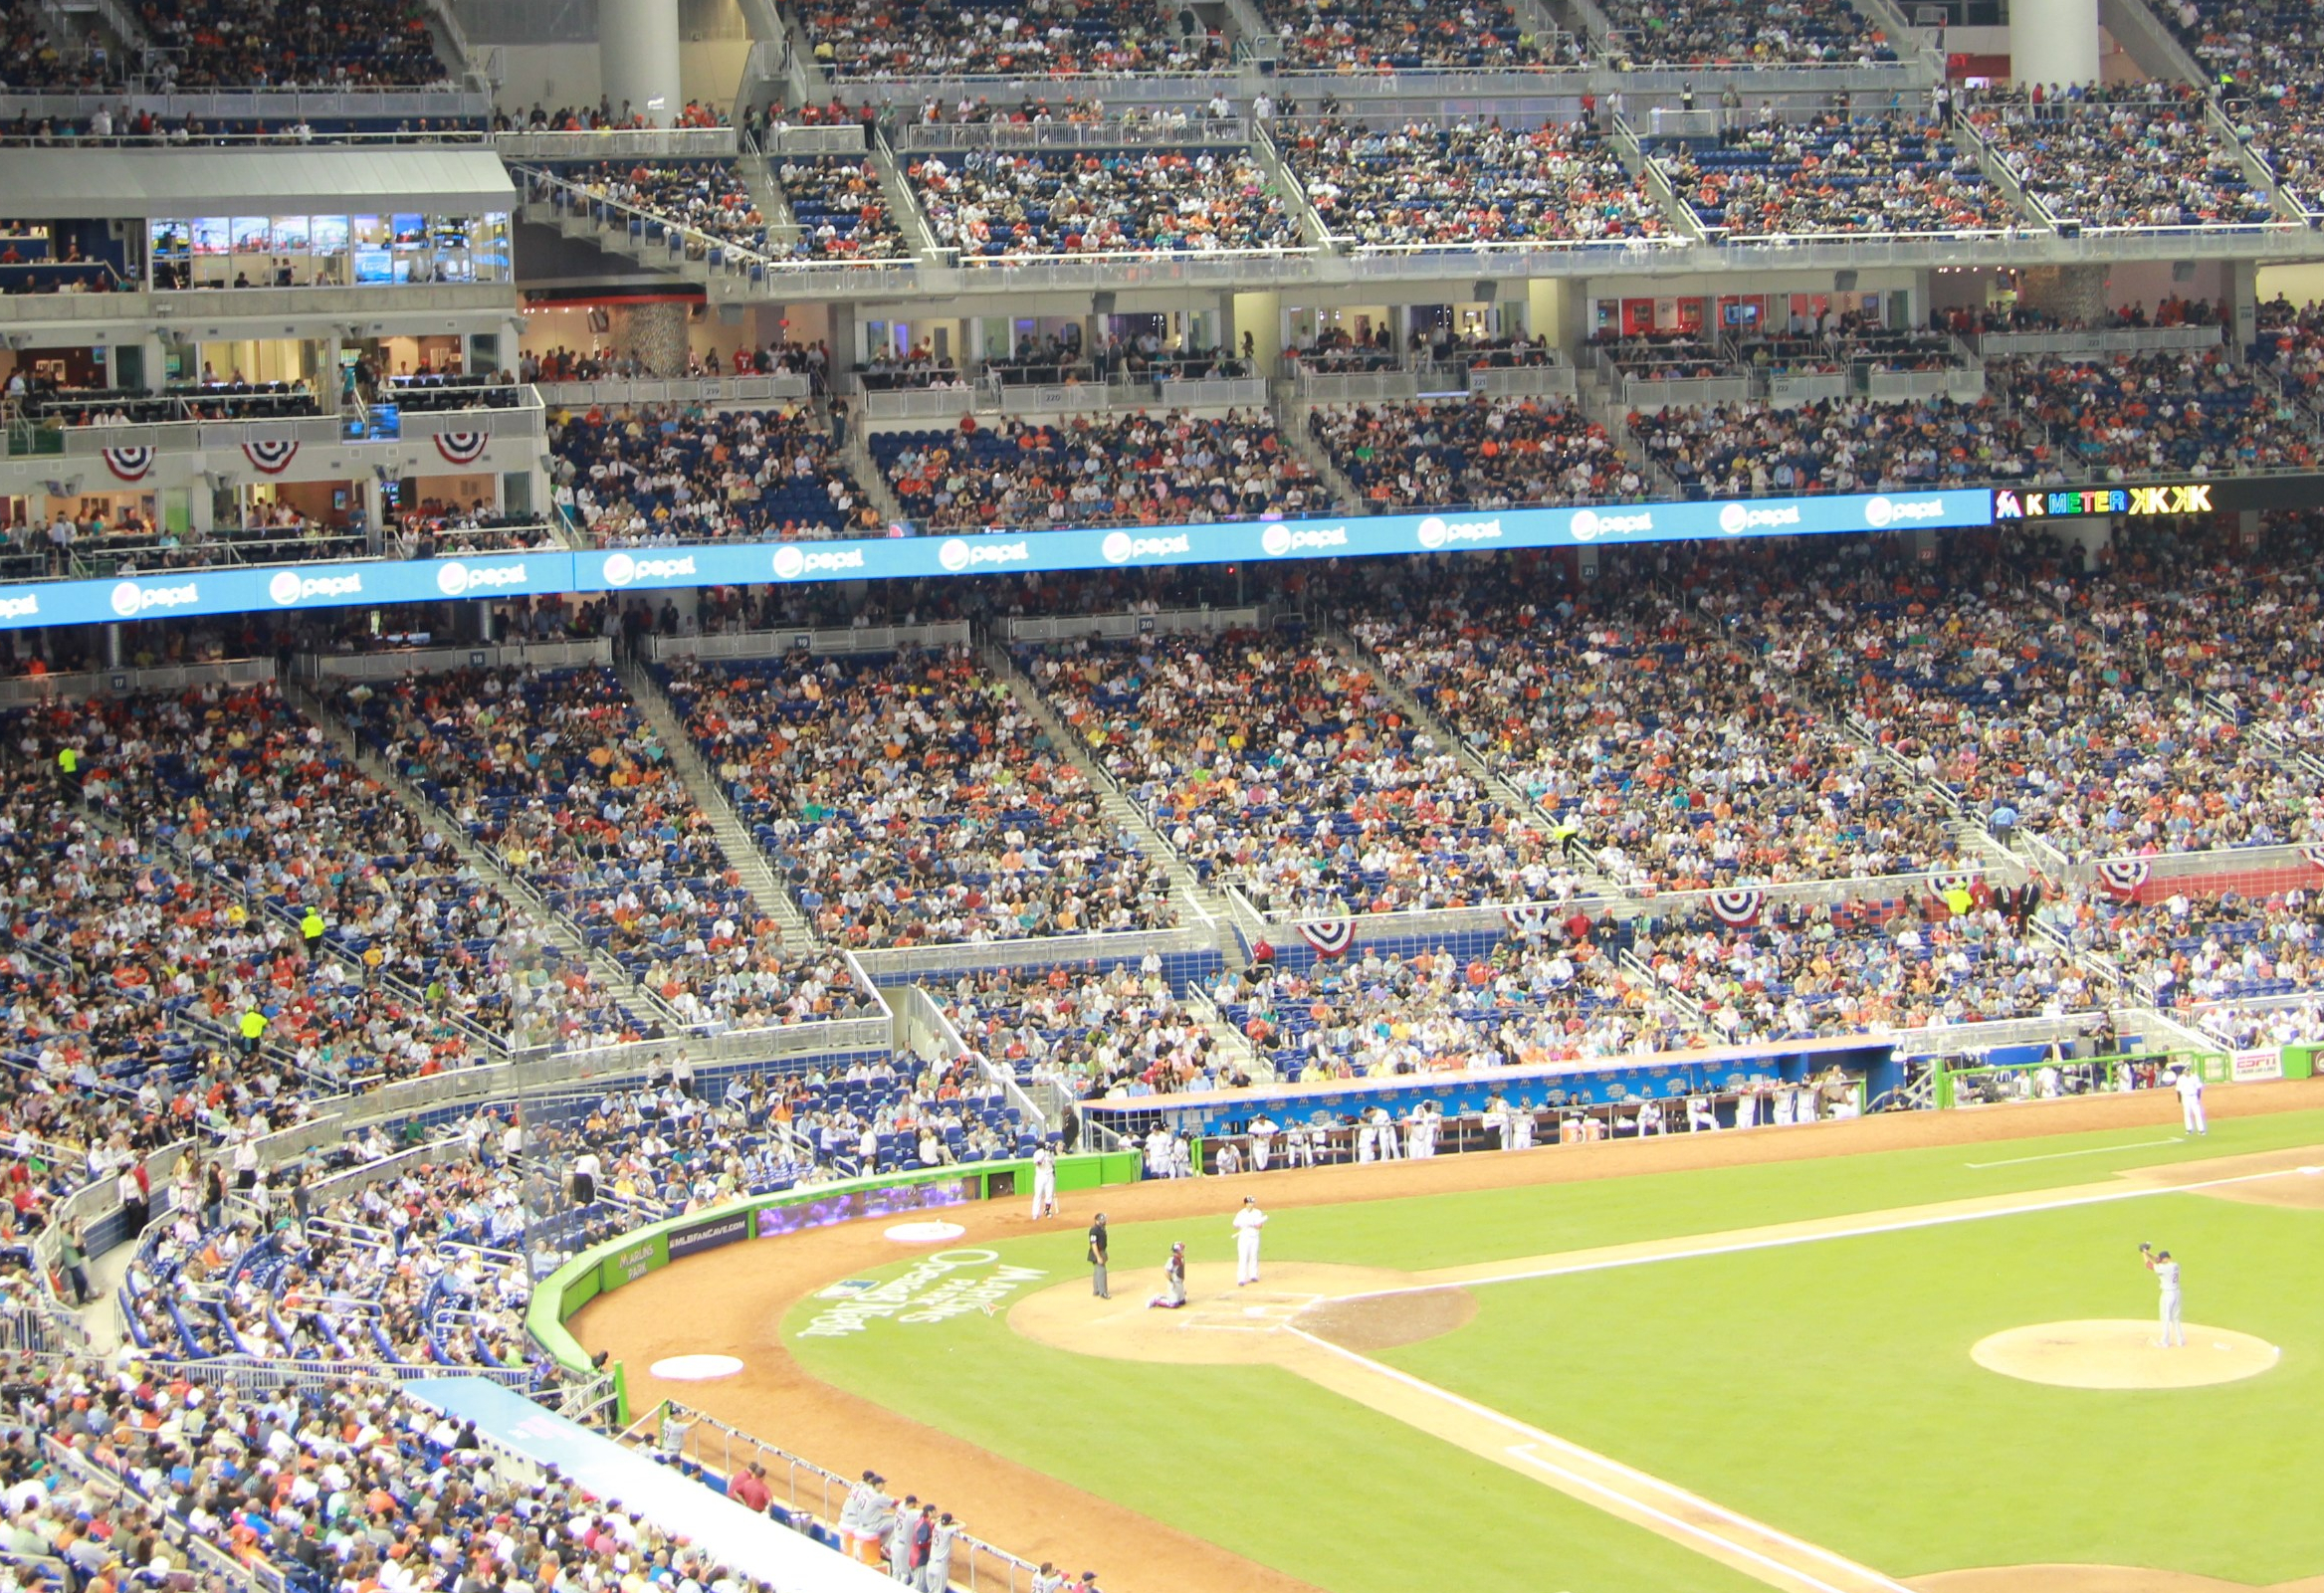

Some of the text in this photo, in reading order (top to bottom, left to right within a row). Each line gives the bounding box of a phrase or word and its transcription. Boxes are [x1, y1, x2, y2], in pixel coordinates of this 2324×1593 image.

[706, 387, 720, 396] 219
[1892, 499, 1944, 521] pepsi
[2026, 494, 2044, 516] K
[2048, 490, 2127, 514] METER
[1598, 512, 1653, 535] pepsi
[1747, 505, 1800, 528] pepsi
[1292, 526, 1348, 550] pepsi
[1447, 519, 1502, 542] pepsi
[970, 541, 1028, 565] pepsi
[1133, 533, 1190, 558] pepsi
[1921, 550, 1931, 560] 22
[635, 555, 696, 579] pepsi
[804, 548, 864, 572] pepsi
[1585, 566, 1593, 576] 21
[302, 573, 362, 598] pepsi
[469, 564, 528, 589] pepsi
[0, 594, 39, 619] epsi
[141, 583, 198, 610] pepsi
[1141, 620, 1153, 630] 20
[797, 638, 808, 648] 19
[473, 655, 483, 664] 18
[113, 678, 124, 688] 17
[2236, 1054, 2276, 1069] ESPN
[619, 1244, 654, 1269] MARLINS
[628, 1263, 647, 1280] PARK
[795, 1249, 999, 1337] Opening Night
[898, 1264, 1049, 1323] MARLINS
[905, 1278, 976, 1305] PARK
